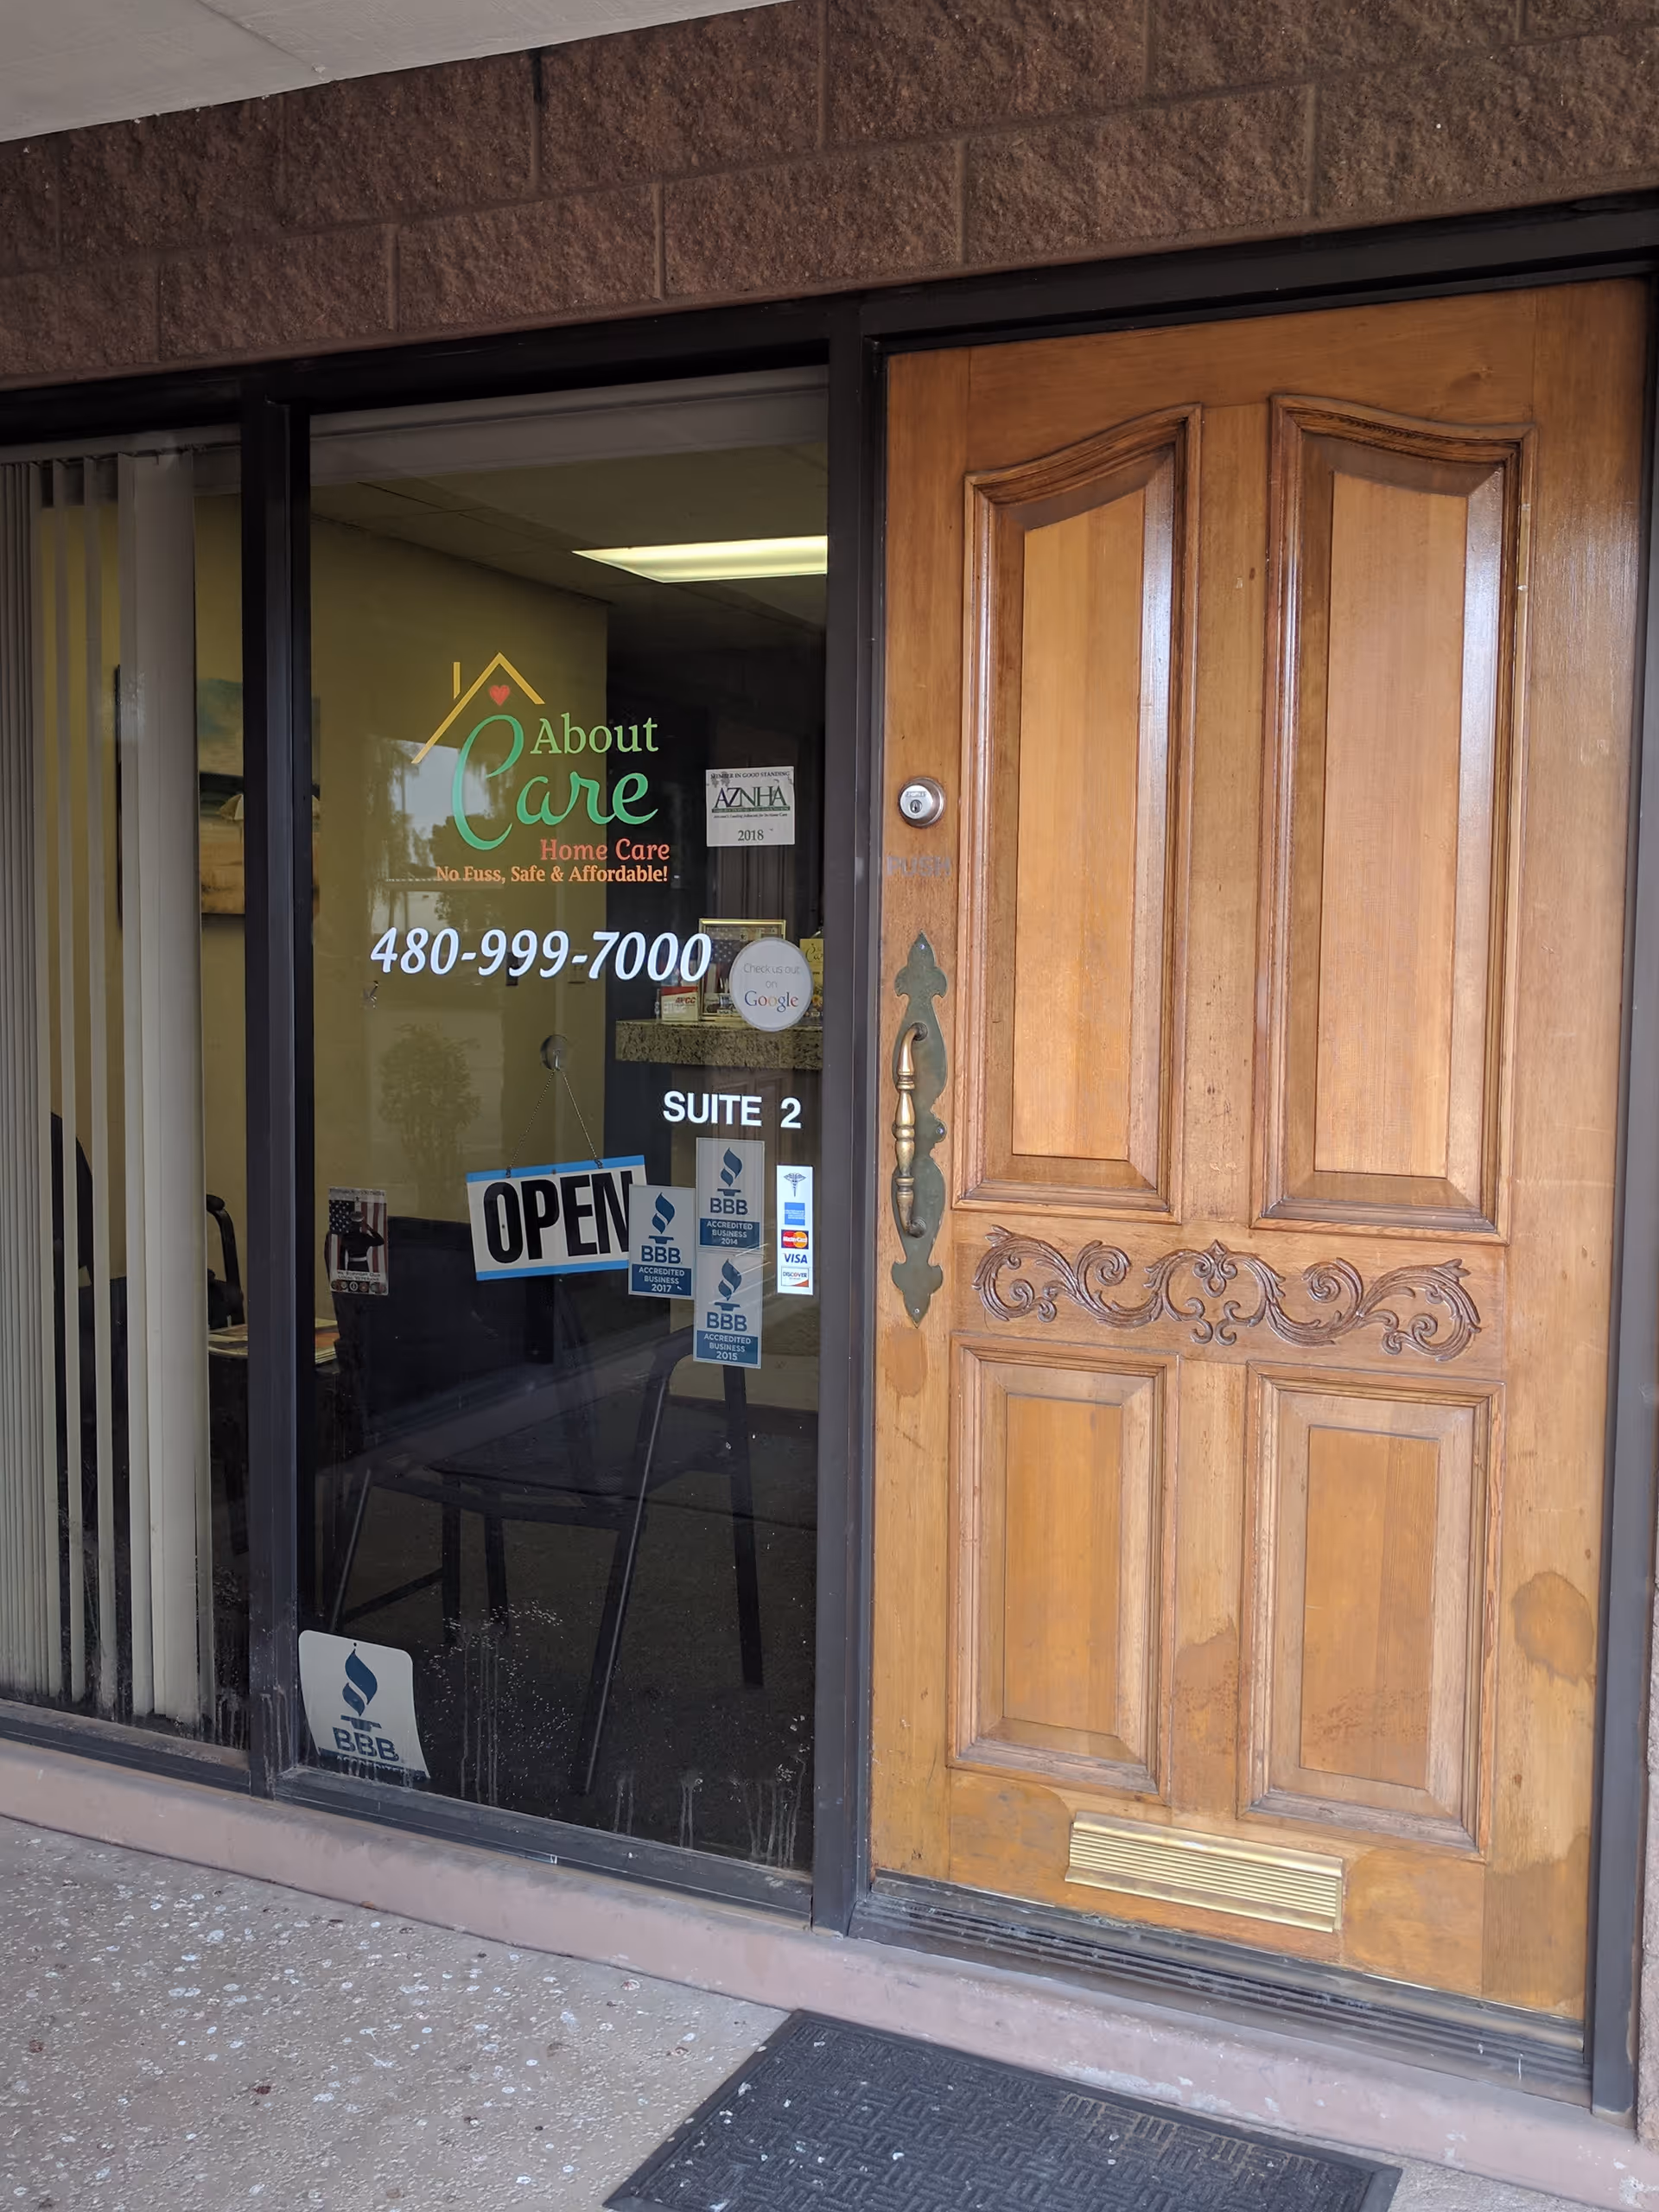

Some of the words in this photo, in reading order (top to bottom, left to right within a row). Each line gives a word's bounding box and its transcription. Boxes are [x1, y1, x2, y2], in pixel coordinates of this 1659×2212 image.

[530, 712, 658, 754] About
[451, 715, 658, 850] Care
[714, 785, 788, 808] AZNHA
[738, 830, 764, 841] 2018
[540, 838, 607, 861] Home
[615, 838, 670, 861] Care
[435, 866, 460, 882] No
[463, 866, 505, 884] Fuss,
[511, 865, 545, 882] Safe
[550, 866, 563, 882] &
[569, 865, 668, 882] Affordable!
[886, 855, 952, 877] PUSH
[370, 926, 712, 982] 480-999-7000
[743, 963, 772, 974] Check
[772, 965, 783, 974] us
[785, 964, 800, 974] out
[766, 981, 778, 989] on
[744, 990, 799, 1013] Google
[663, 1090, 763, 1127] SUITE
[780, 1097, 802, 1129] 2
[710, 1198, 748, 1216] BBB
[483, 1170, 633, 1264] OPEN
[707, 1221, 753, 1230] ACCREDITED
[712, 1229, 747, 1238] BUSINESS
[721, 1237, 738, 1246] 2014
[641, 1245, 681, 1265] BBB
[784, 1254, 808, 1264] VISA
[639, 1267, 684, 1277] ACCREDITED
[644, 1275, 679, 1285] BUSINESS
[652, 1284, 671, 1293] 2017
[707, 1312, 747, 1332] BBB
[703, 1333, 751, 1344] ACCREDITED
[709, 1343, 746, 1352] BUSINESS
[716, 1351, 738, 1362] 2015
[332, 1726, 399, 1762] BBB
